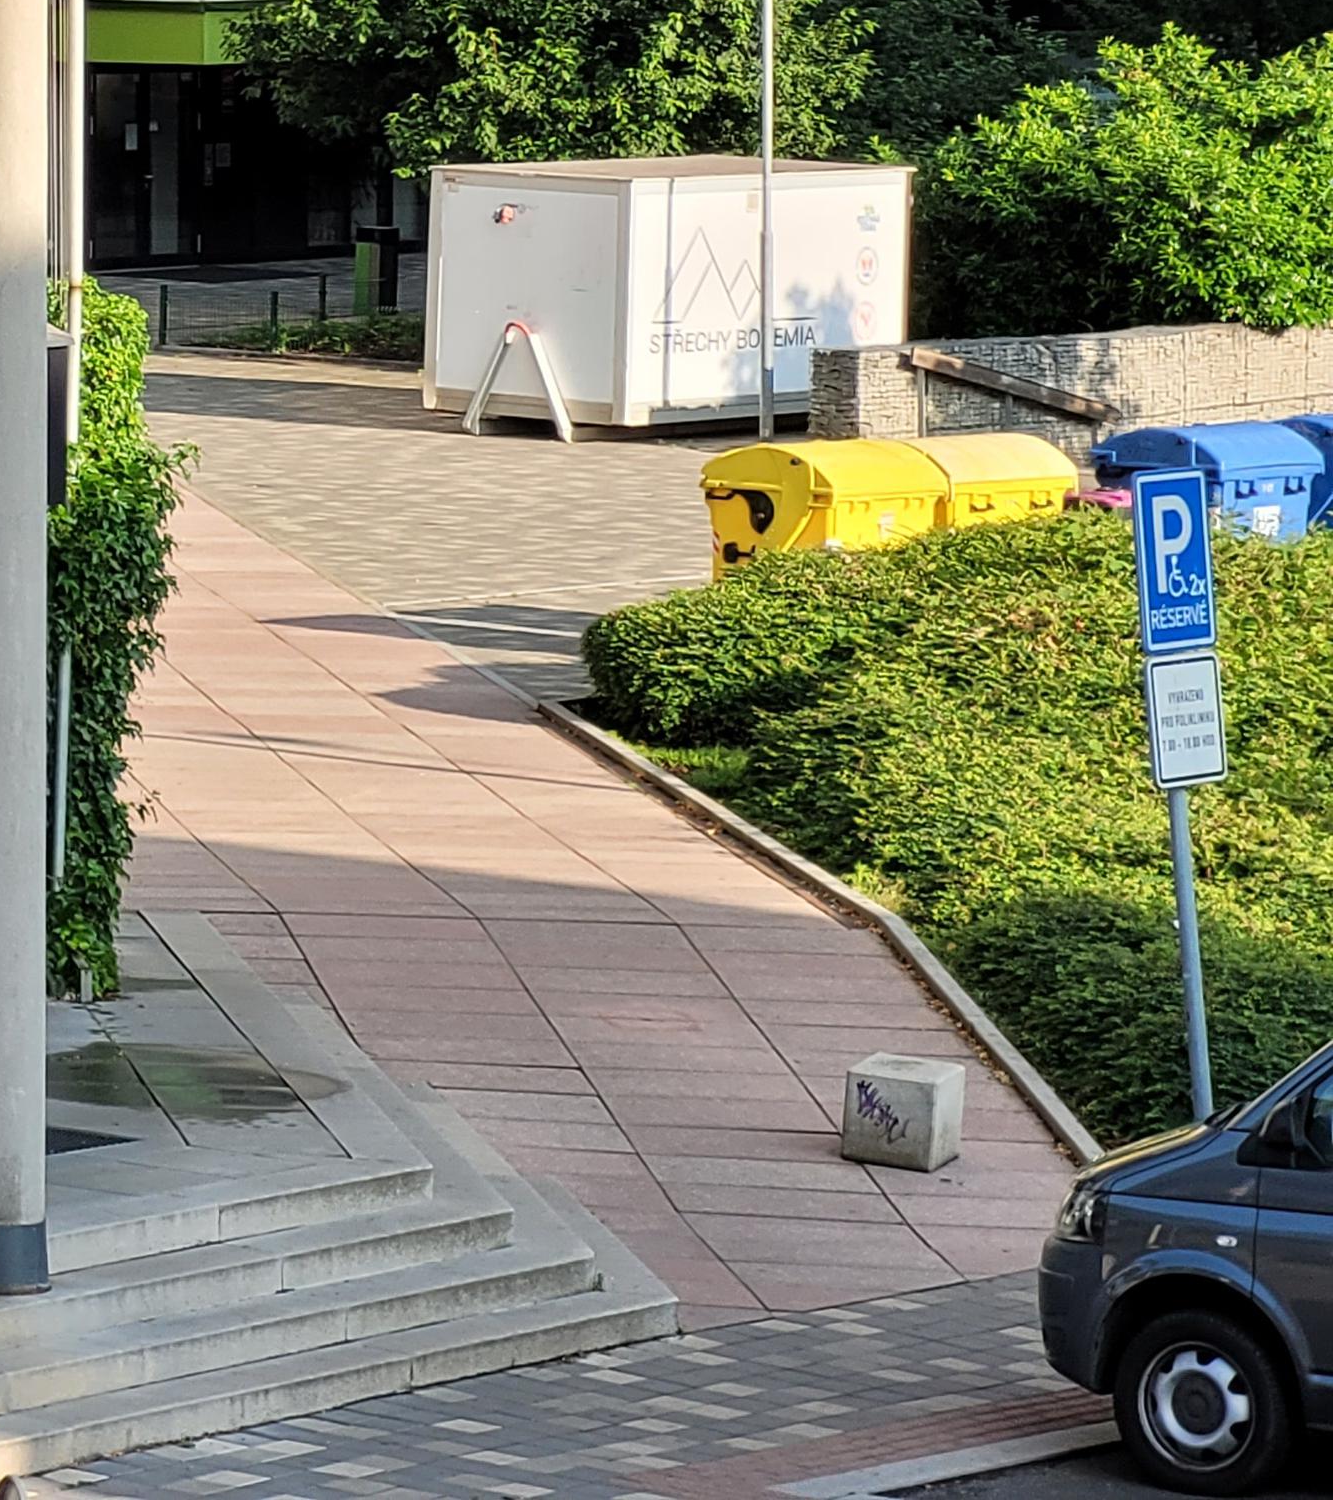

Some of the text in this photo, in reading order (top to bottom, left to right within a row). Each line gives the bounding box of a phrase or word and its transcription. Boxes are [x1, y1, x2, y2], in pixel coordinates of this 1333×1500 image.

[649, 326, 817, 354] STŘECHY BOEMIA
[1151, 494, 1193, 594] P
[1189, 573, 1206, 596] 2x
[1150, 599, 1209, 630] RÉSERVÉ
